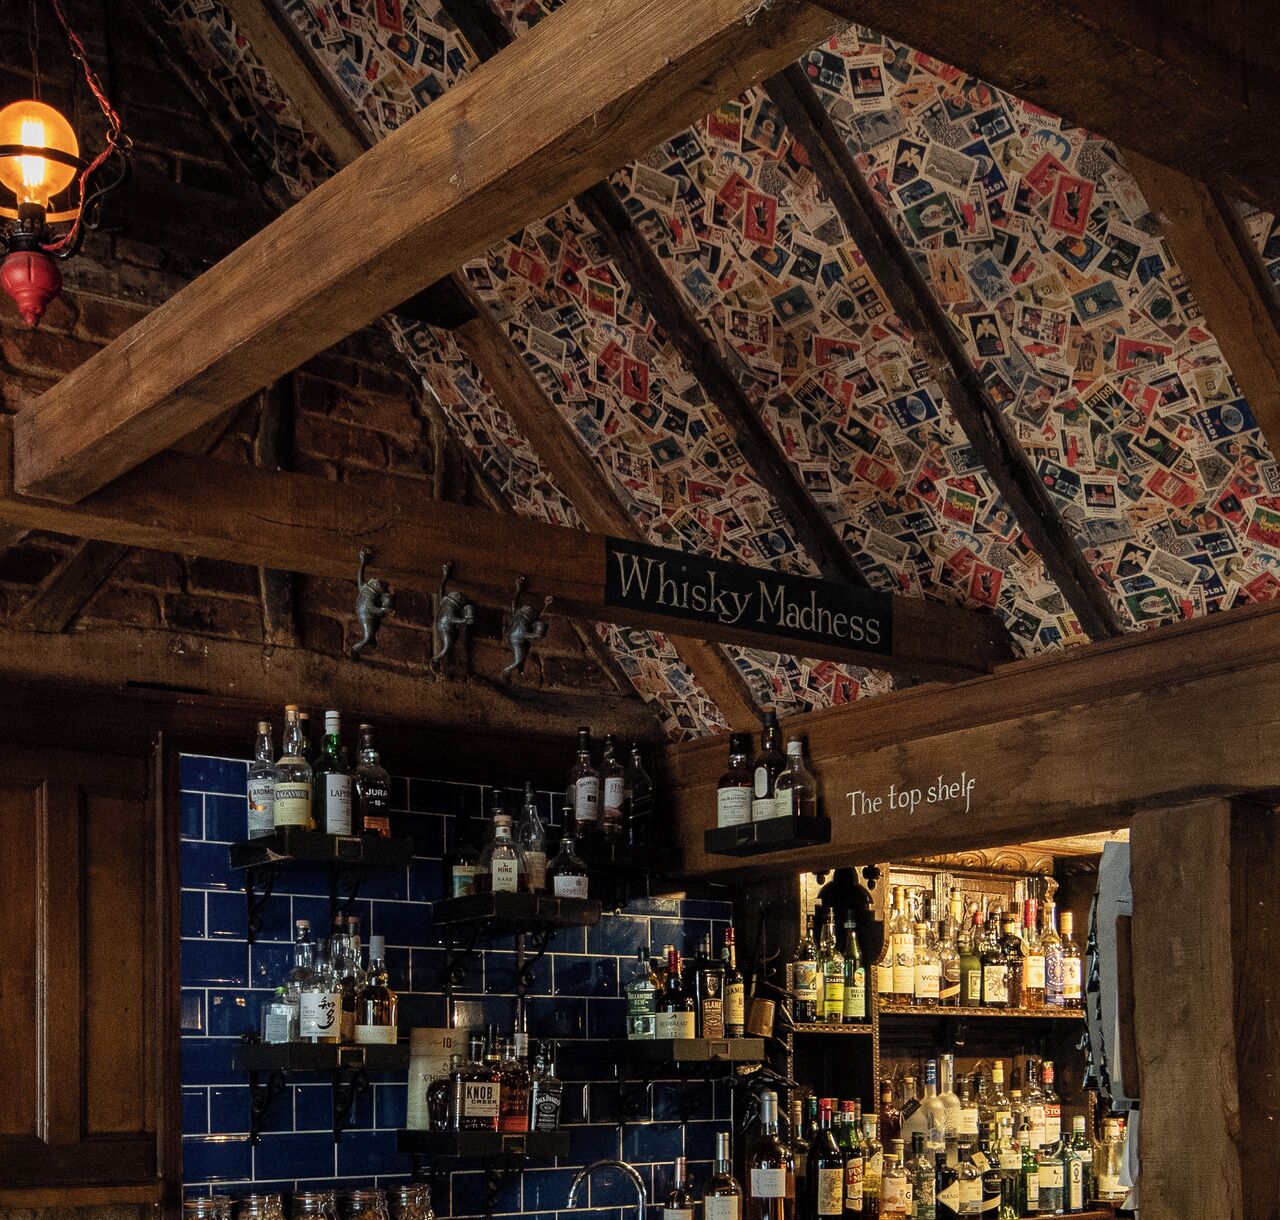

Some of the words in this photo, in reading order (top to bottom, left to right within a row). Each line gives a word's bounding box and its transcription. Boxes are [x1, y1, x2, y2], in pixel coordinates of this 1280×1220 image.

[984, 180, 1005, 196] OLDI
[612, 551, 752, 624] Whisky
[757, 580, 881, 645] Madness
[365, 788, 388, 797] JURA
[846, 790, 883, 816] The
[888, 785, 922, 814] top
[927, 771, 976, 813] shelf
[704, 1000, 722, 1009] SLANE
[466, 1086, 493, 1099] KNOB
